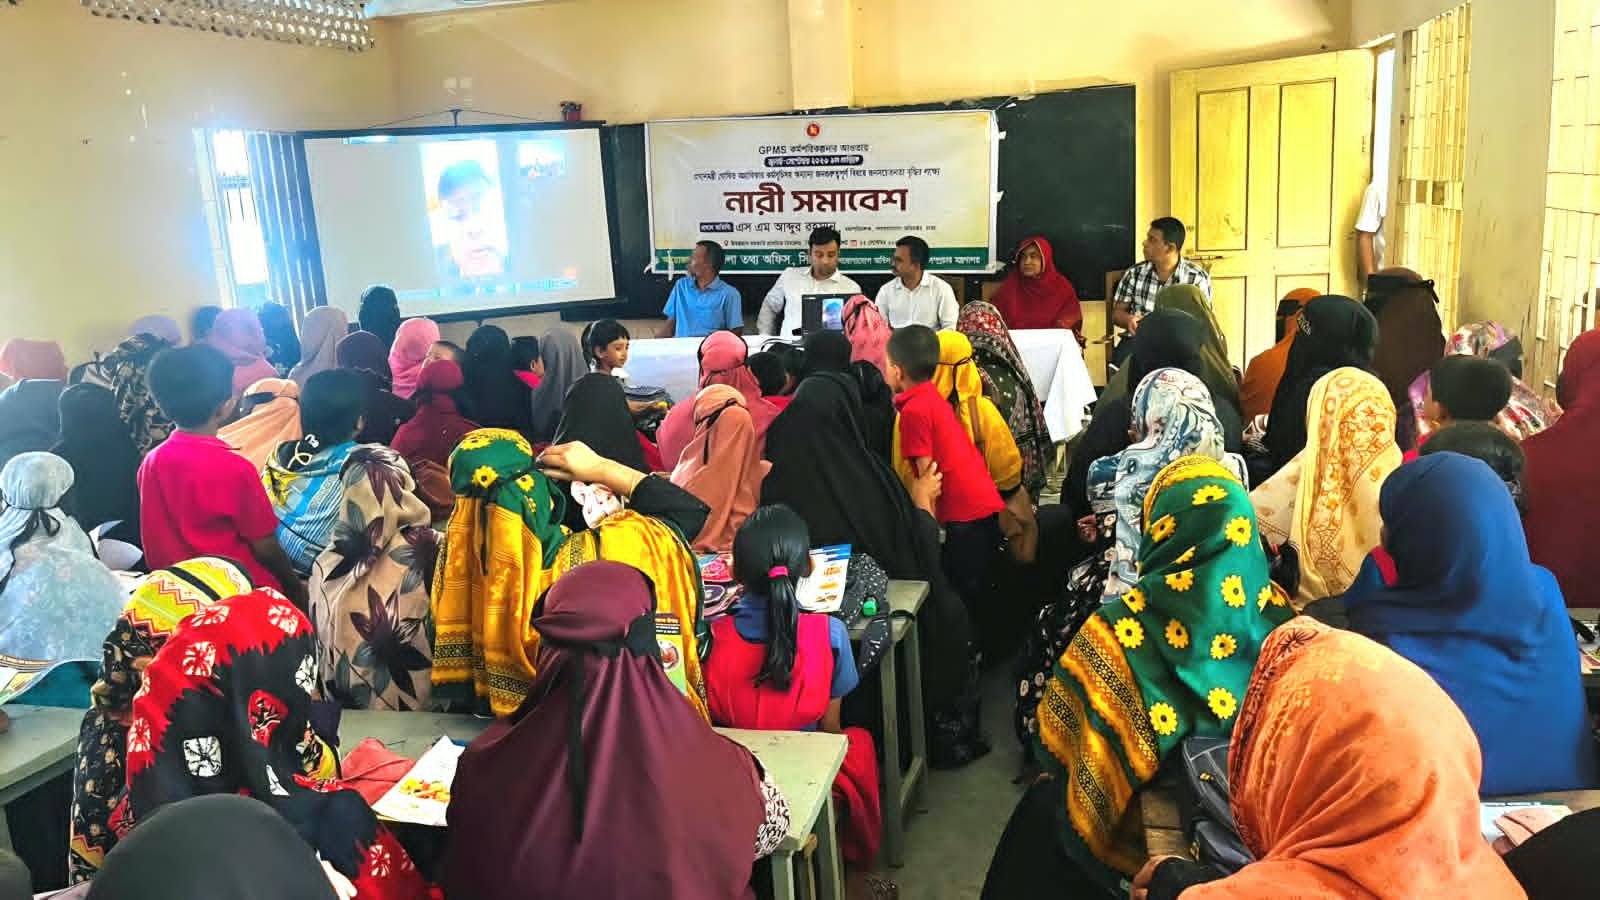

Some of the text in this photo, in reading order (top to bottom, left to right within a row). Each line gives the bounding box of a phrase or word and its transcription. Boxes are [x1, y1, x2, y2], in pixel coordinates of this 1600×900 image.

[759, 145, 787, 154] GPMS
[723, 182, 908, 216] নারী সমাবেশ
[735, 222, 752, 232] এস
[754, 222, 770, 232] এম
[724, 255, 736, 264] লা
[741, 254, 758, 264] তথ্য
